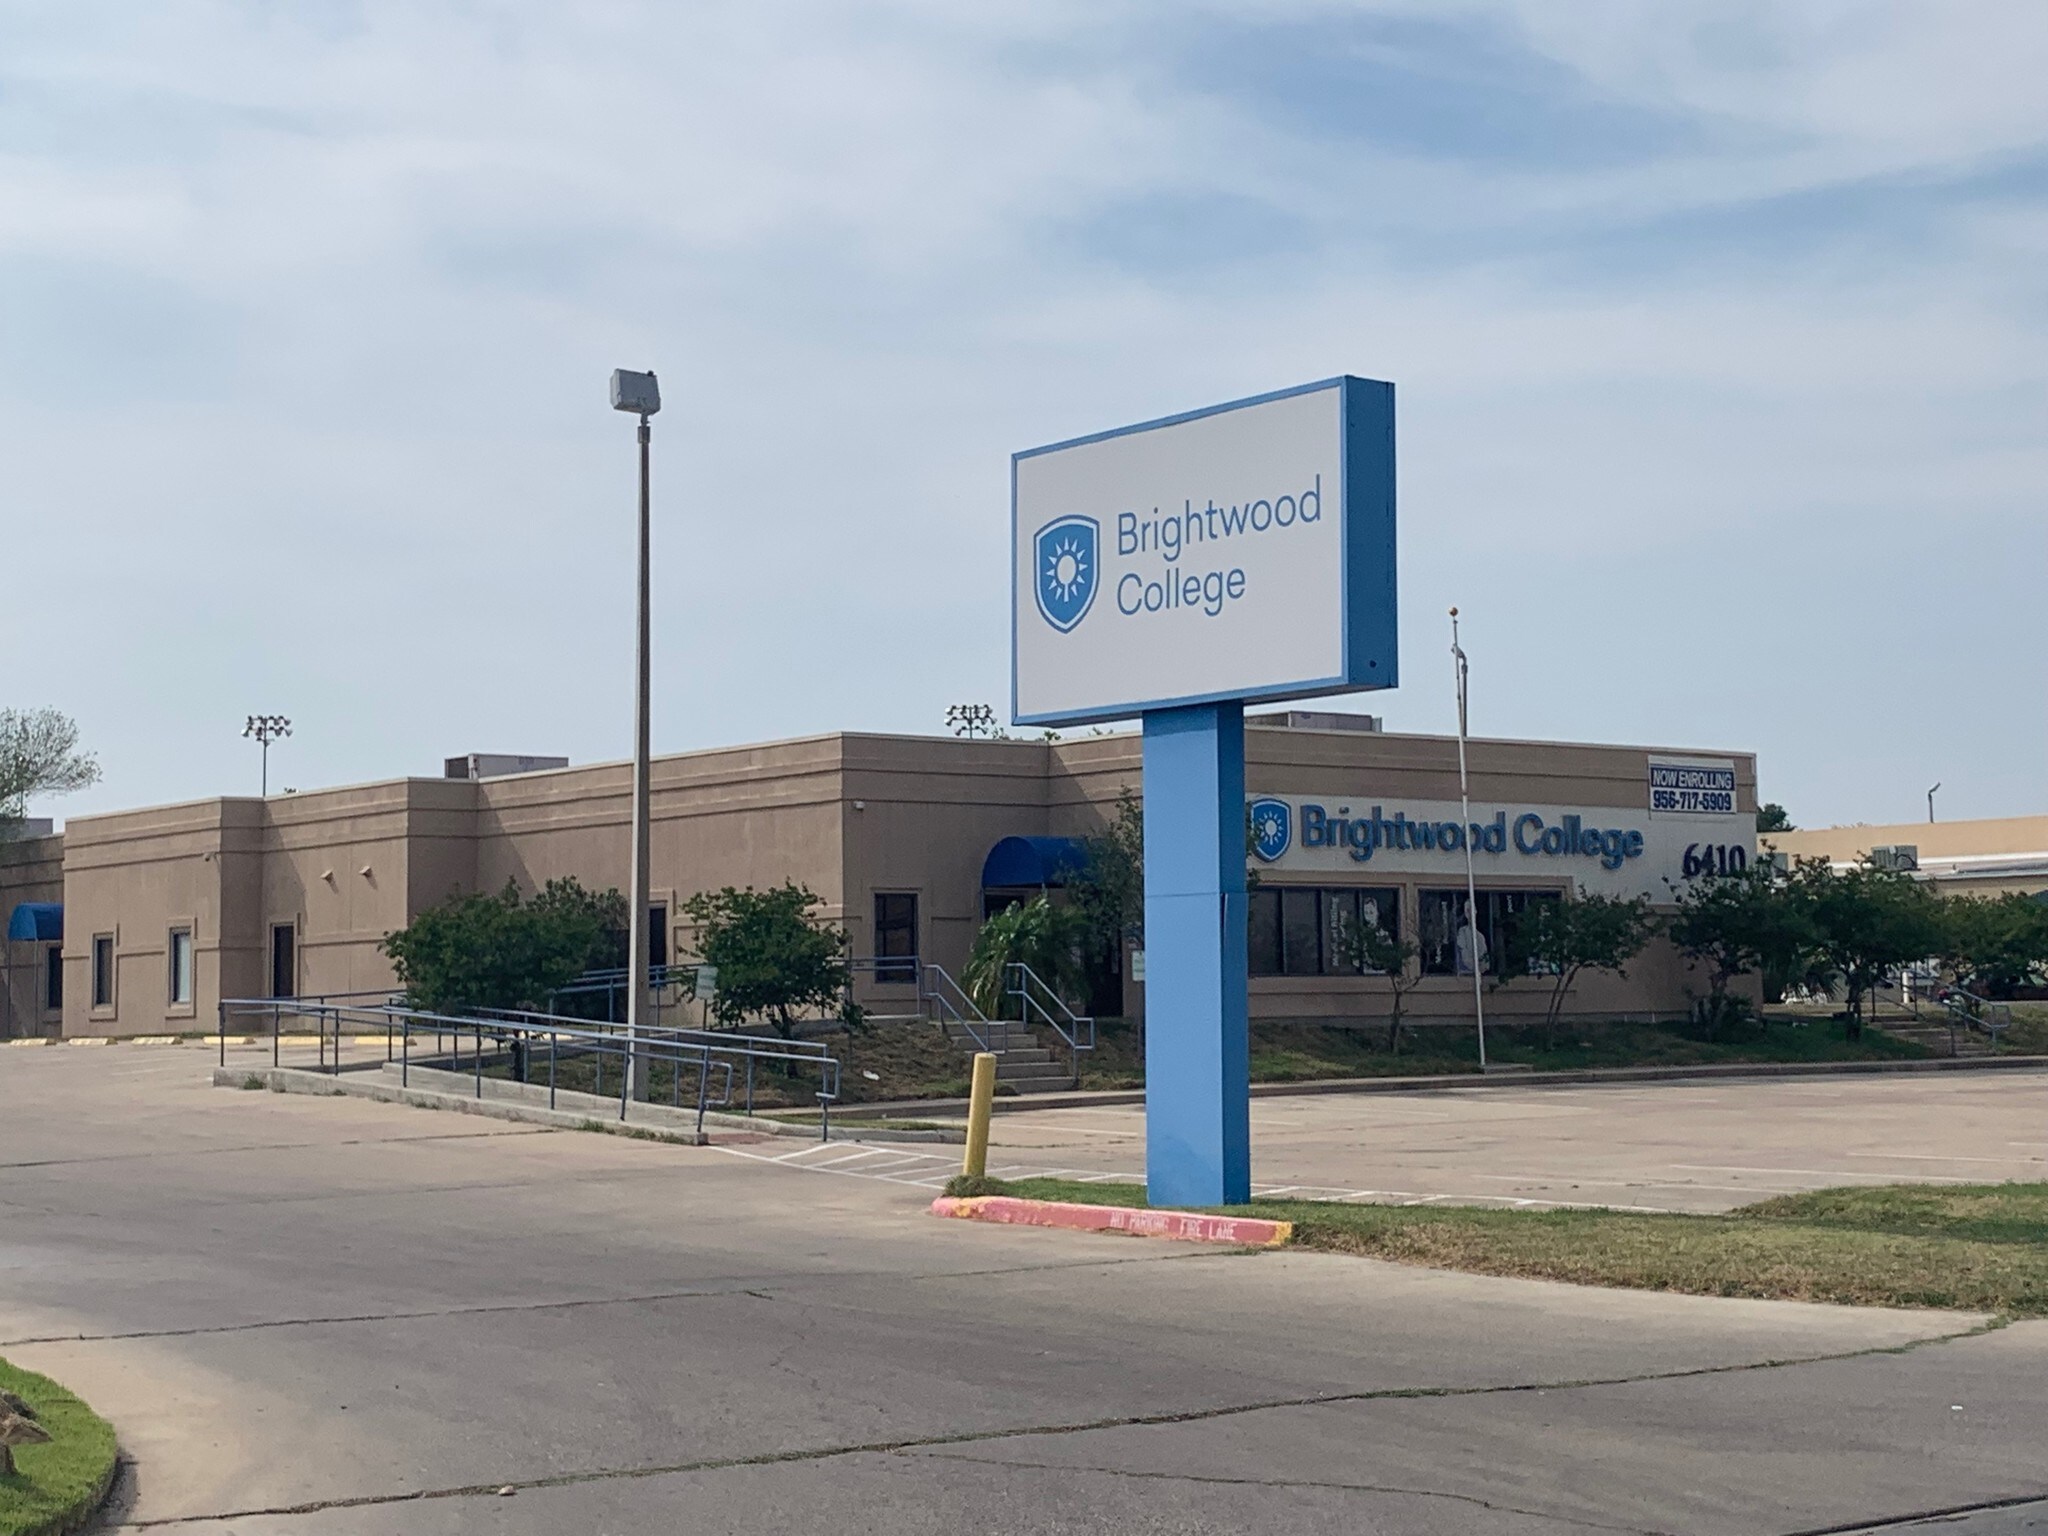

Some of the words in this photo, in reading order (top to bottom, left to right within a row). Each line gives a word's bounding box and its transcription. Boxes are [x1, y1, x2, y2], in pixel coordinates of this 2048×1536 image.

[1117, 473, 1322, 562] Brightwood
[1116, 567, 1246, 617] College
[1652, 768, 1677, 787] NOW
[1678, 770, 1733, 790] ENROLLING
[1652, 789, 1733, 812] 956-717-5909
[1300, 804, 1507, 863] Brightwood
[1513, 812, 1645, 871] College
[1682, 842, 1747, 877] 6410
[1109, 1211, 1125, 1229] NO
[1129, 1212, 1170, 1234] PARKING
[1180, 1217, 1205, 1238] FIRE
[1208, 1221, 1238, 1241] LANE
